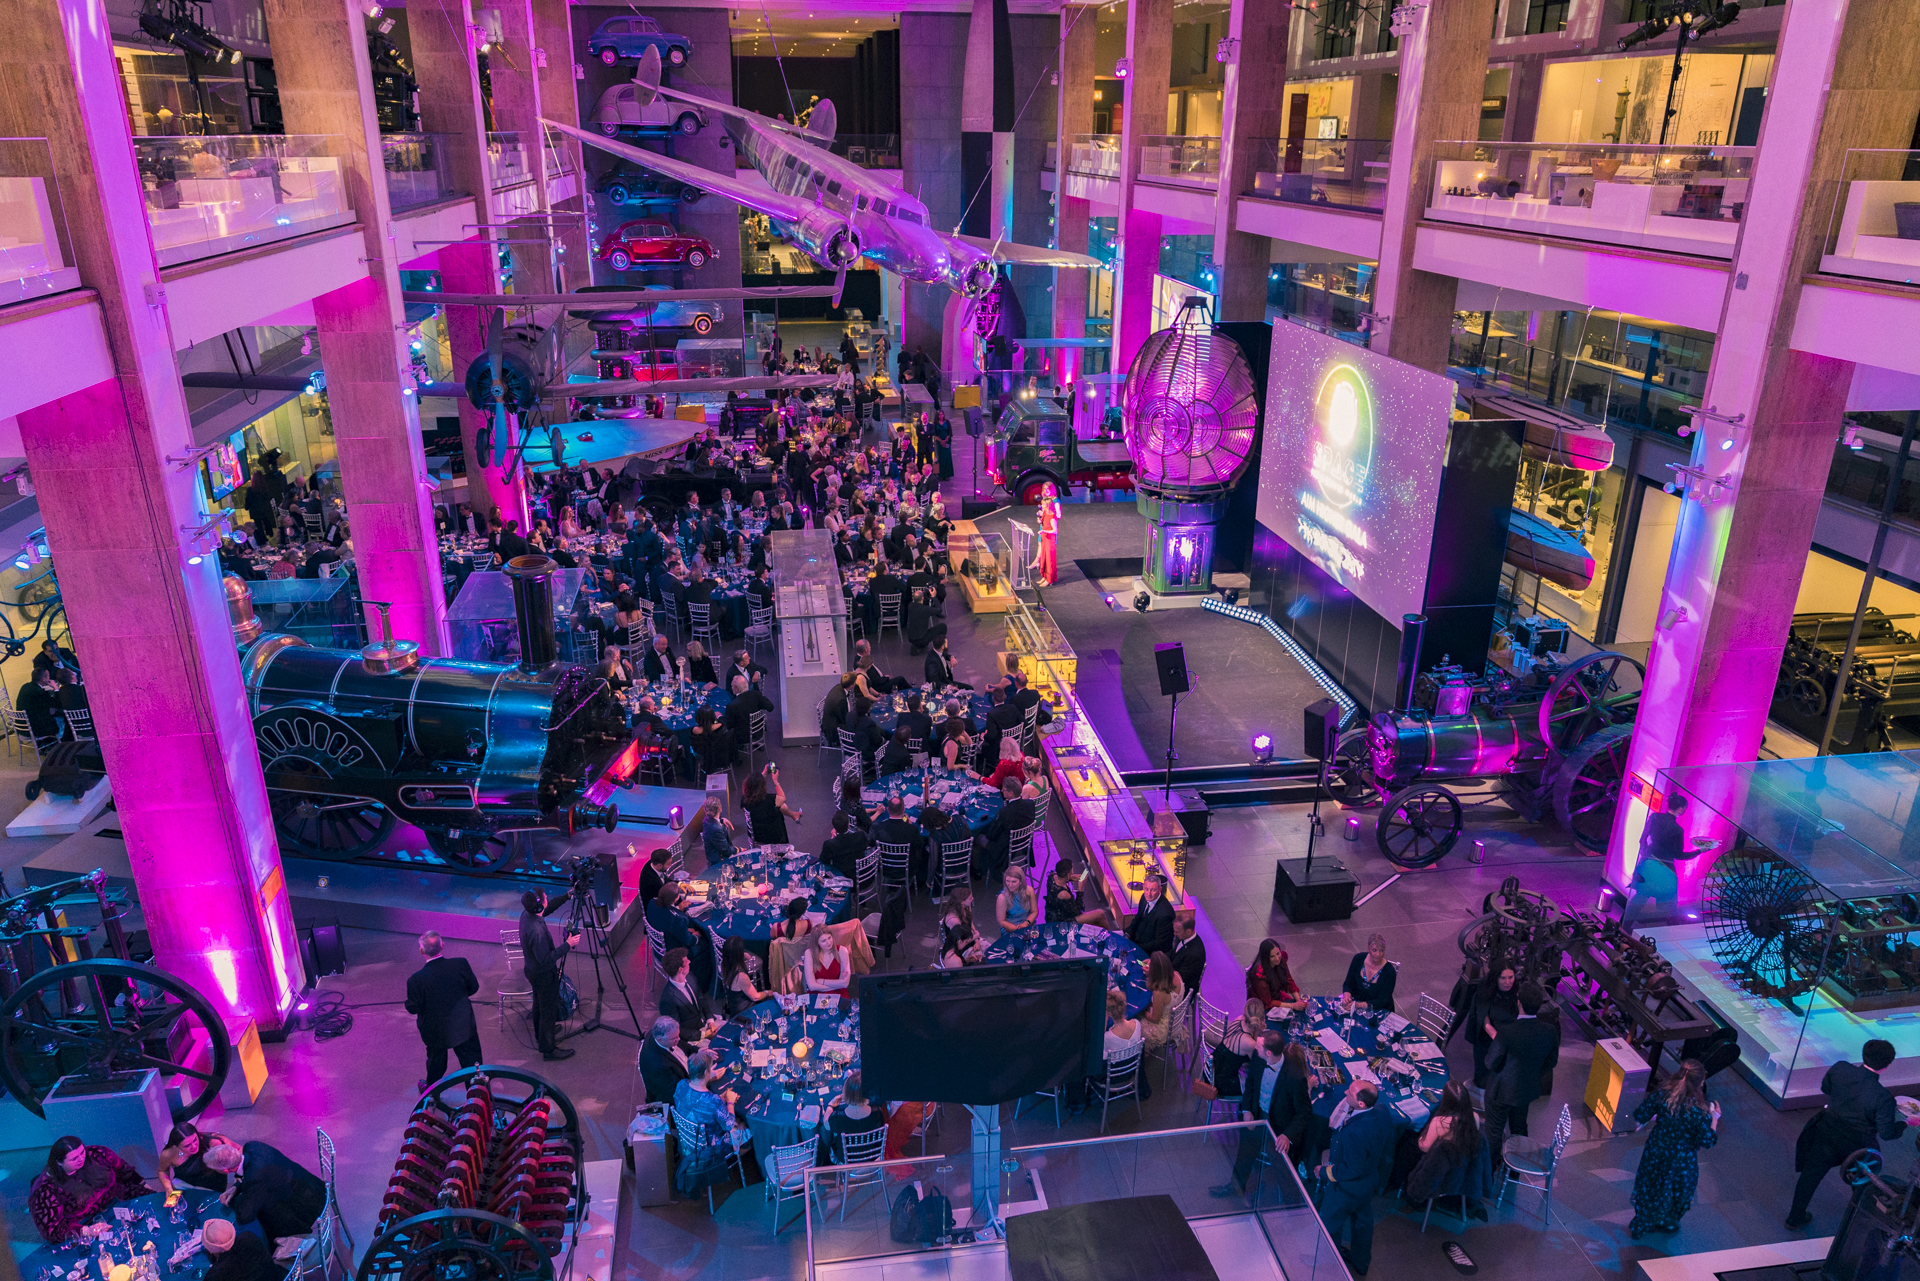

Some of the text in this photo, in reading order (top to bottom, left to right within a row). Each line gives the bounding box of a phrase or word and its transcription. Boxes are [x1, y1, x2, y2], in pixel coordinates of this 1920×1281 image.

[1657, 172, 1693, 180] PUBLIC LAUNDRY
[644, 450, 663, 460] MISS
[1312, 440, 1366, 494] SPACE
[1301, 491, 1316, 513] AIM
